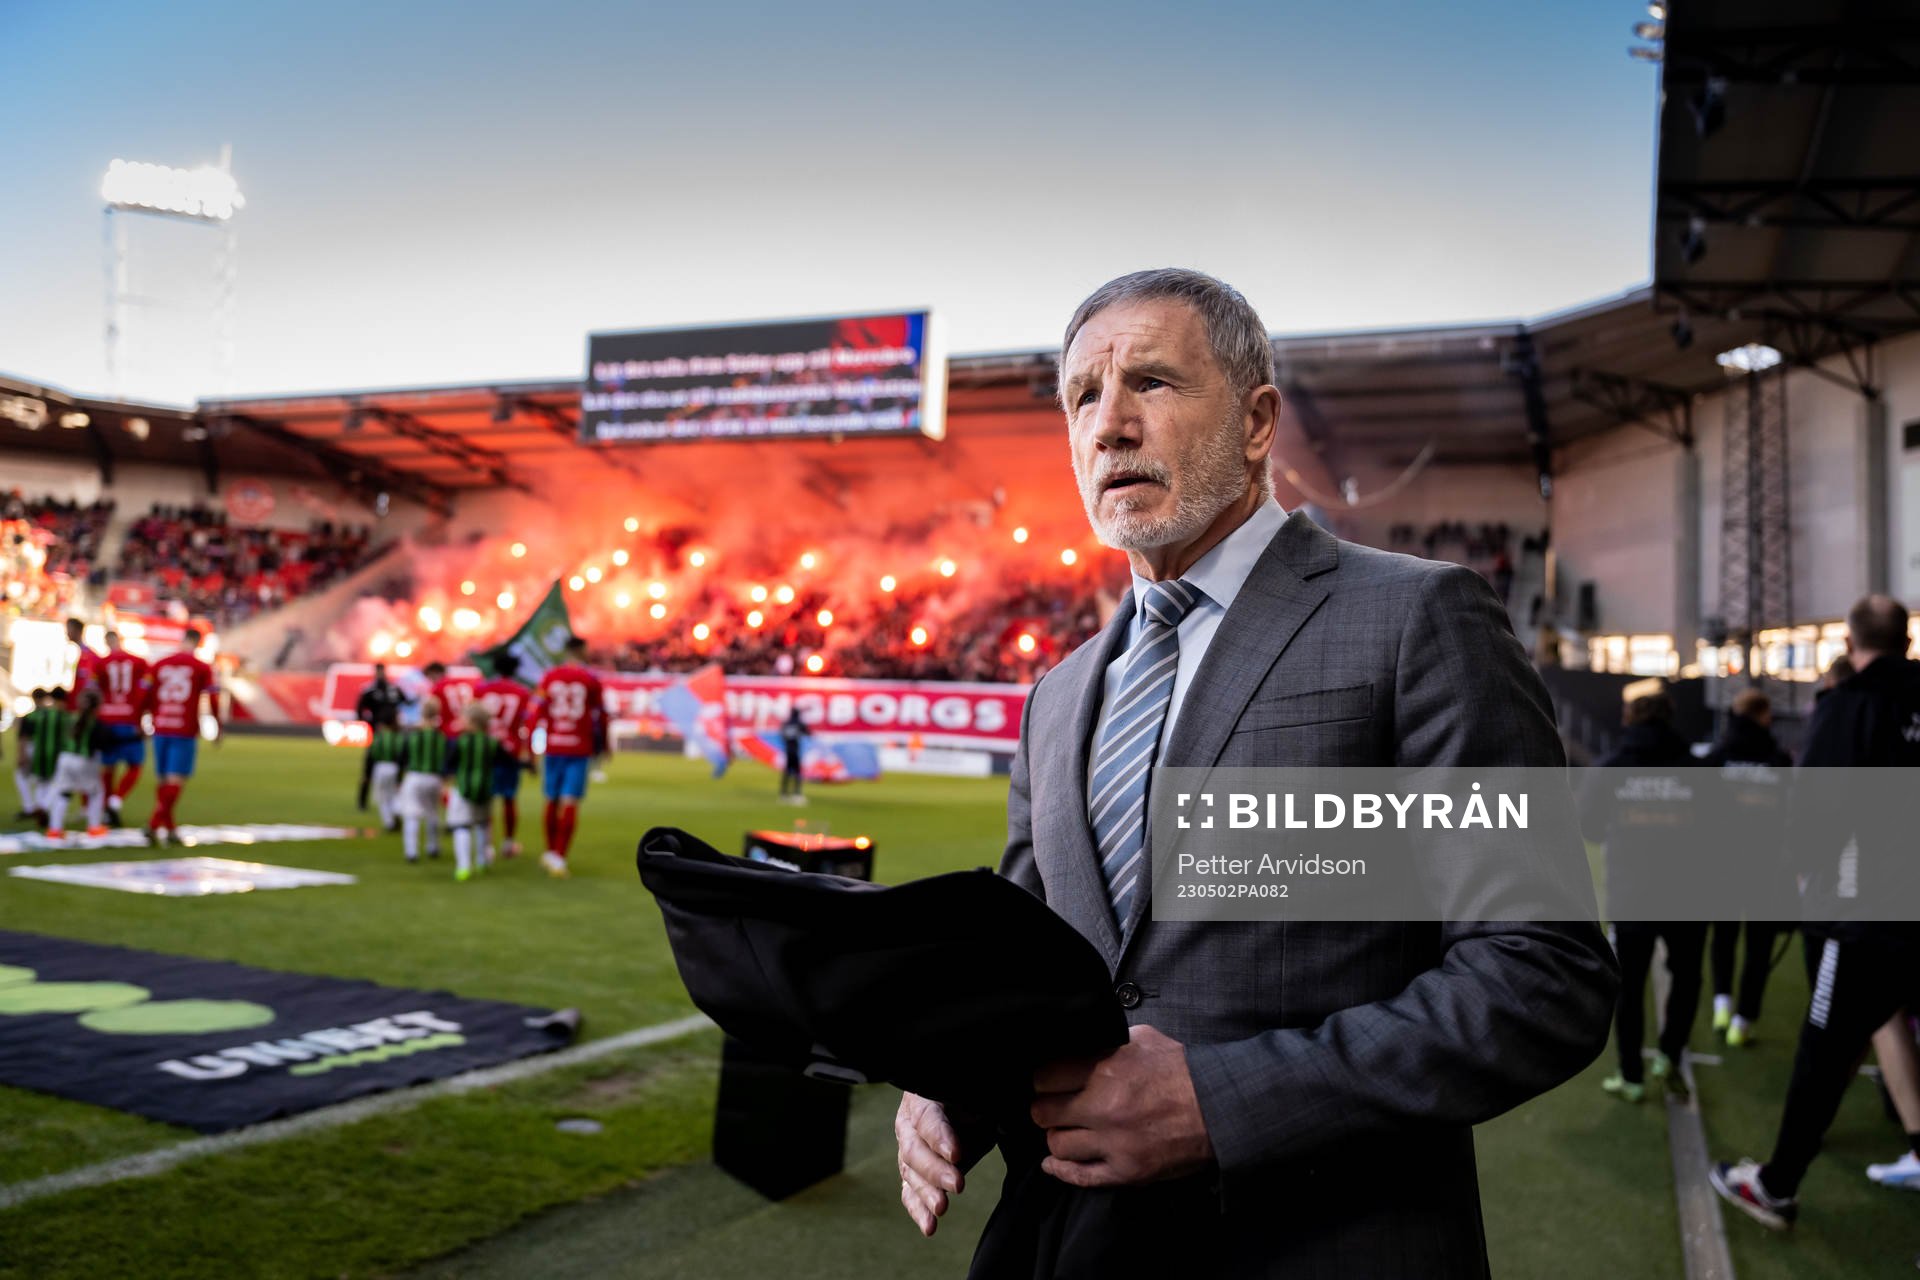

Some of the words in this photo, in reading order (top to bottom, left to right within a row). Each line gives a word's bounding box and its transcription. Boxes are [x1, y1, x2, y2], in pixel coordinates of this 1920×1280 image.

[106, 660, 133, 693] 11
[157, 665, 193, 703] 25
[548, 681, 586, 720] 33
